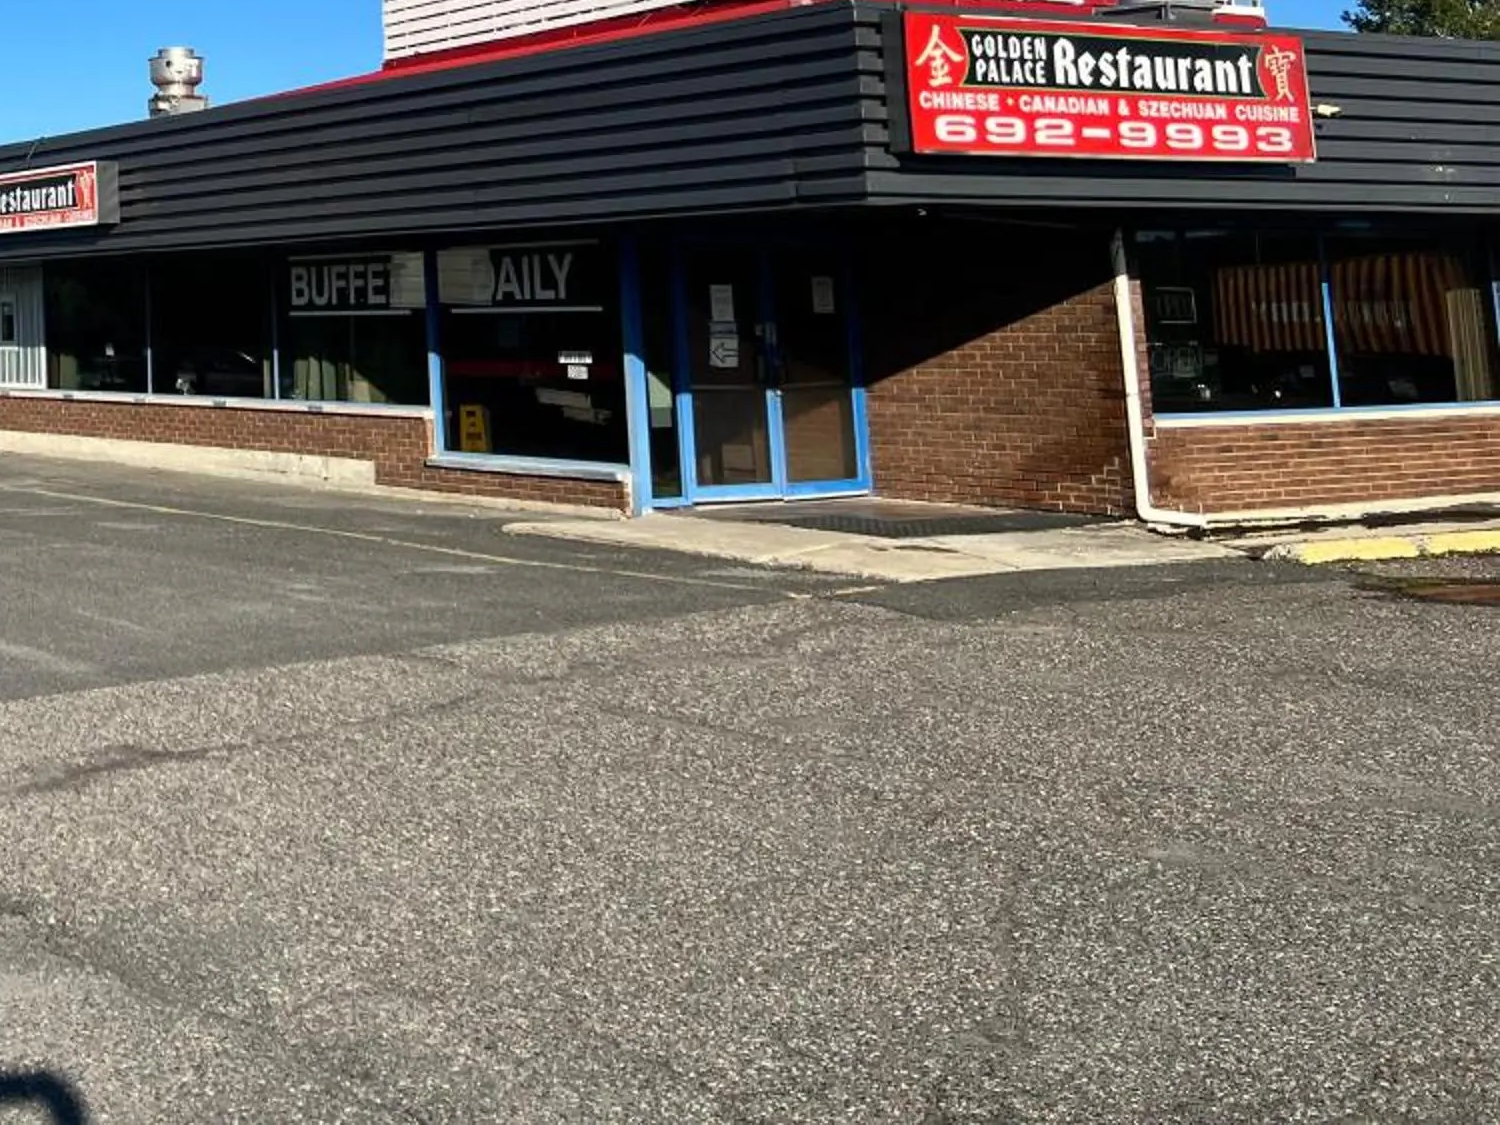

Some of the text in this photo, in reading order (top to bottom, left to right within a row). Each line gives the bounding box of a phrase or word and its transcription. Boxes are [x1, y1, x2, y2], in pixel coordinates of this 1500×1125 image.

[915, 24, 964, 88] 金
[971, 34, 1252, 94] GOLDEN Restaurant
[975, 59, 1047, 85] PALACE
[919, 90, 1301, 124] CHINESE CANADIAN & SZECHUAN CUISINE
[934, 114, 1294, 153] 692-9993
